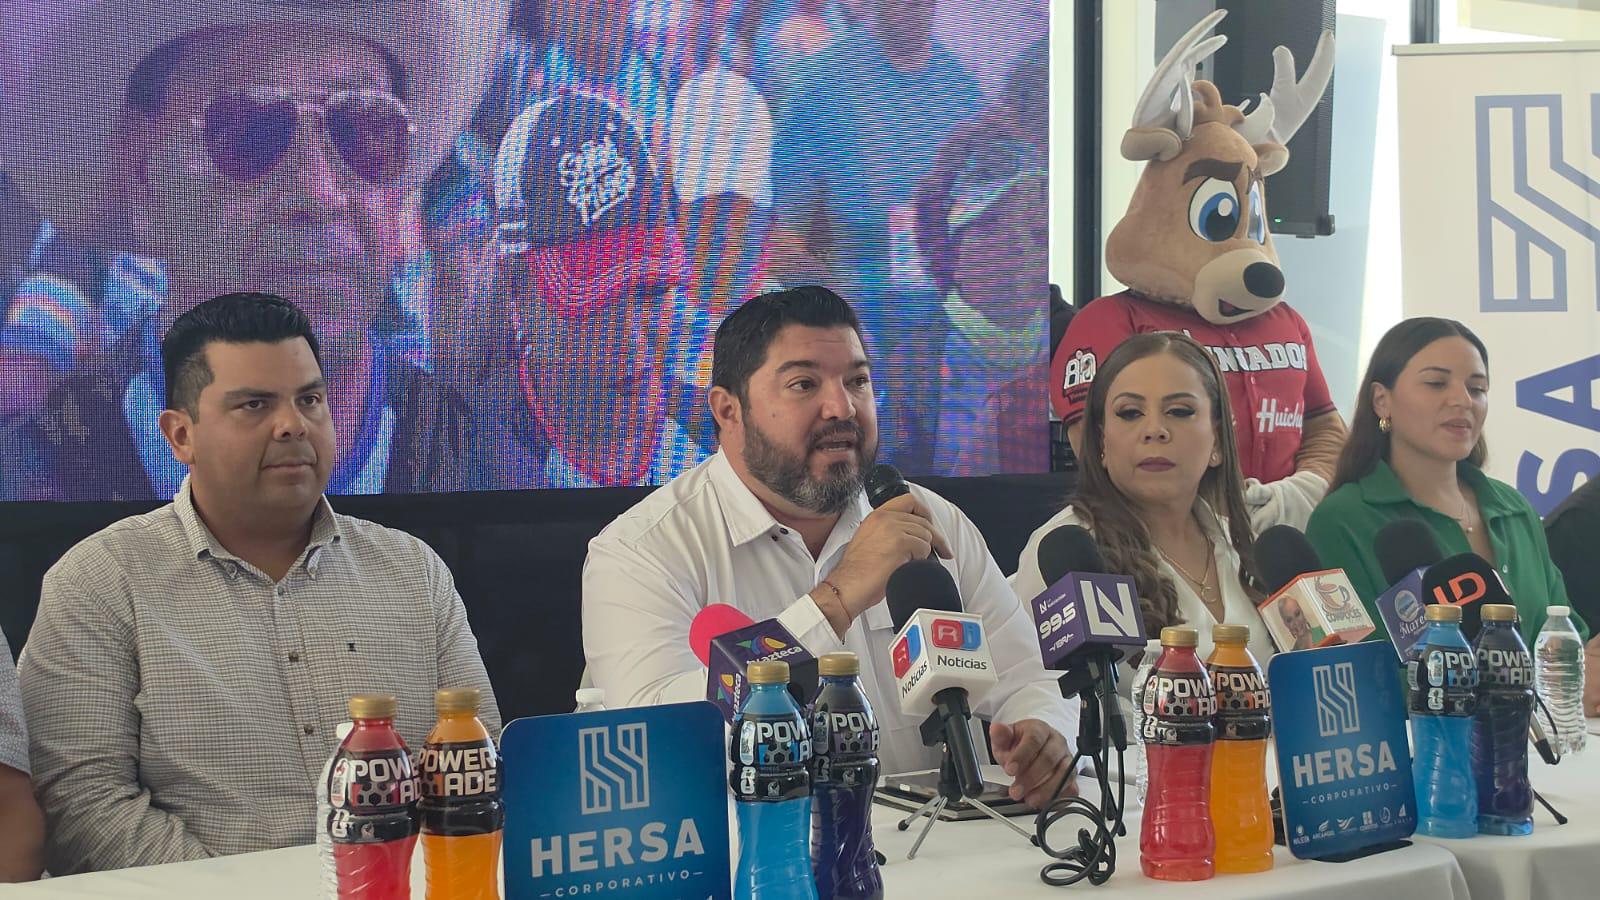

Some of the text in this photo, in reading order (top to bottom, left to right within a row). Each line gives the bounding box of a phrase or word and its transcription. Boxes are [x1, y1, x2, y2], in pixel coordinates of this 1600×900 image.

[1039, 601, 1077, 640] 99.5
[901, 660, 928, 699] Noticias
[937, 654, 988, 671] Noticias
[418, 746, 497, 773] POWER
[1292, 740, 1397, 788] HERSA
[444, 769, 498, 797] ADE
[530, 818, 705, 878] HERSA
[555, 869, 690, 898] CORPORATIVO
